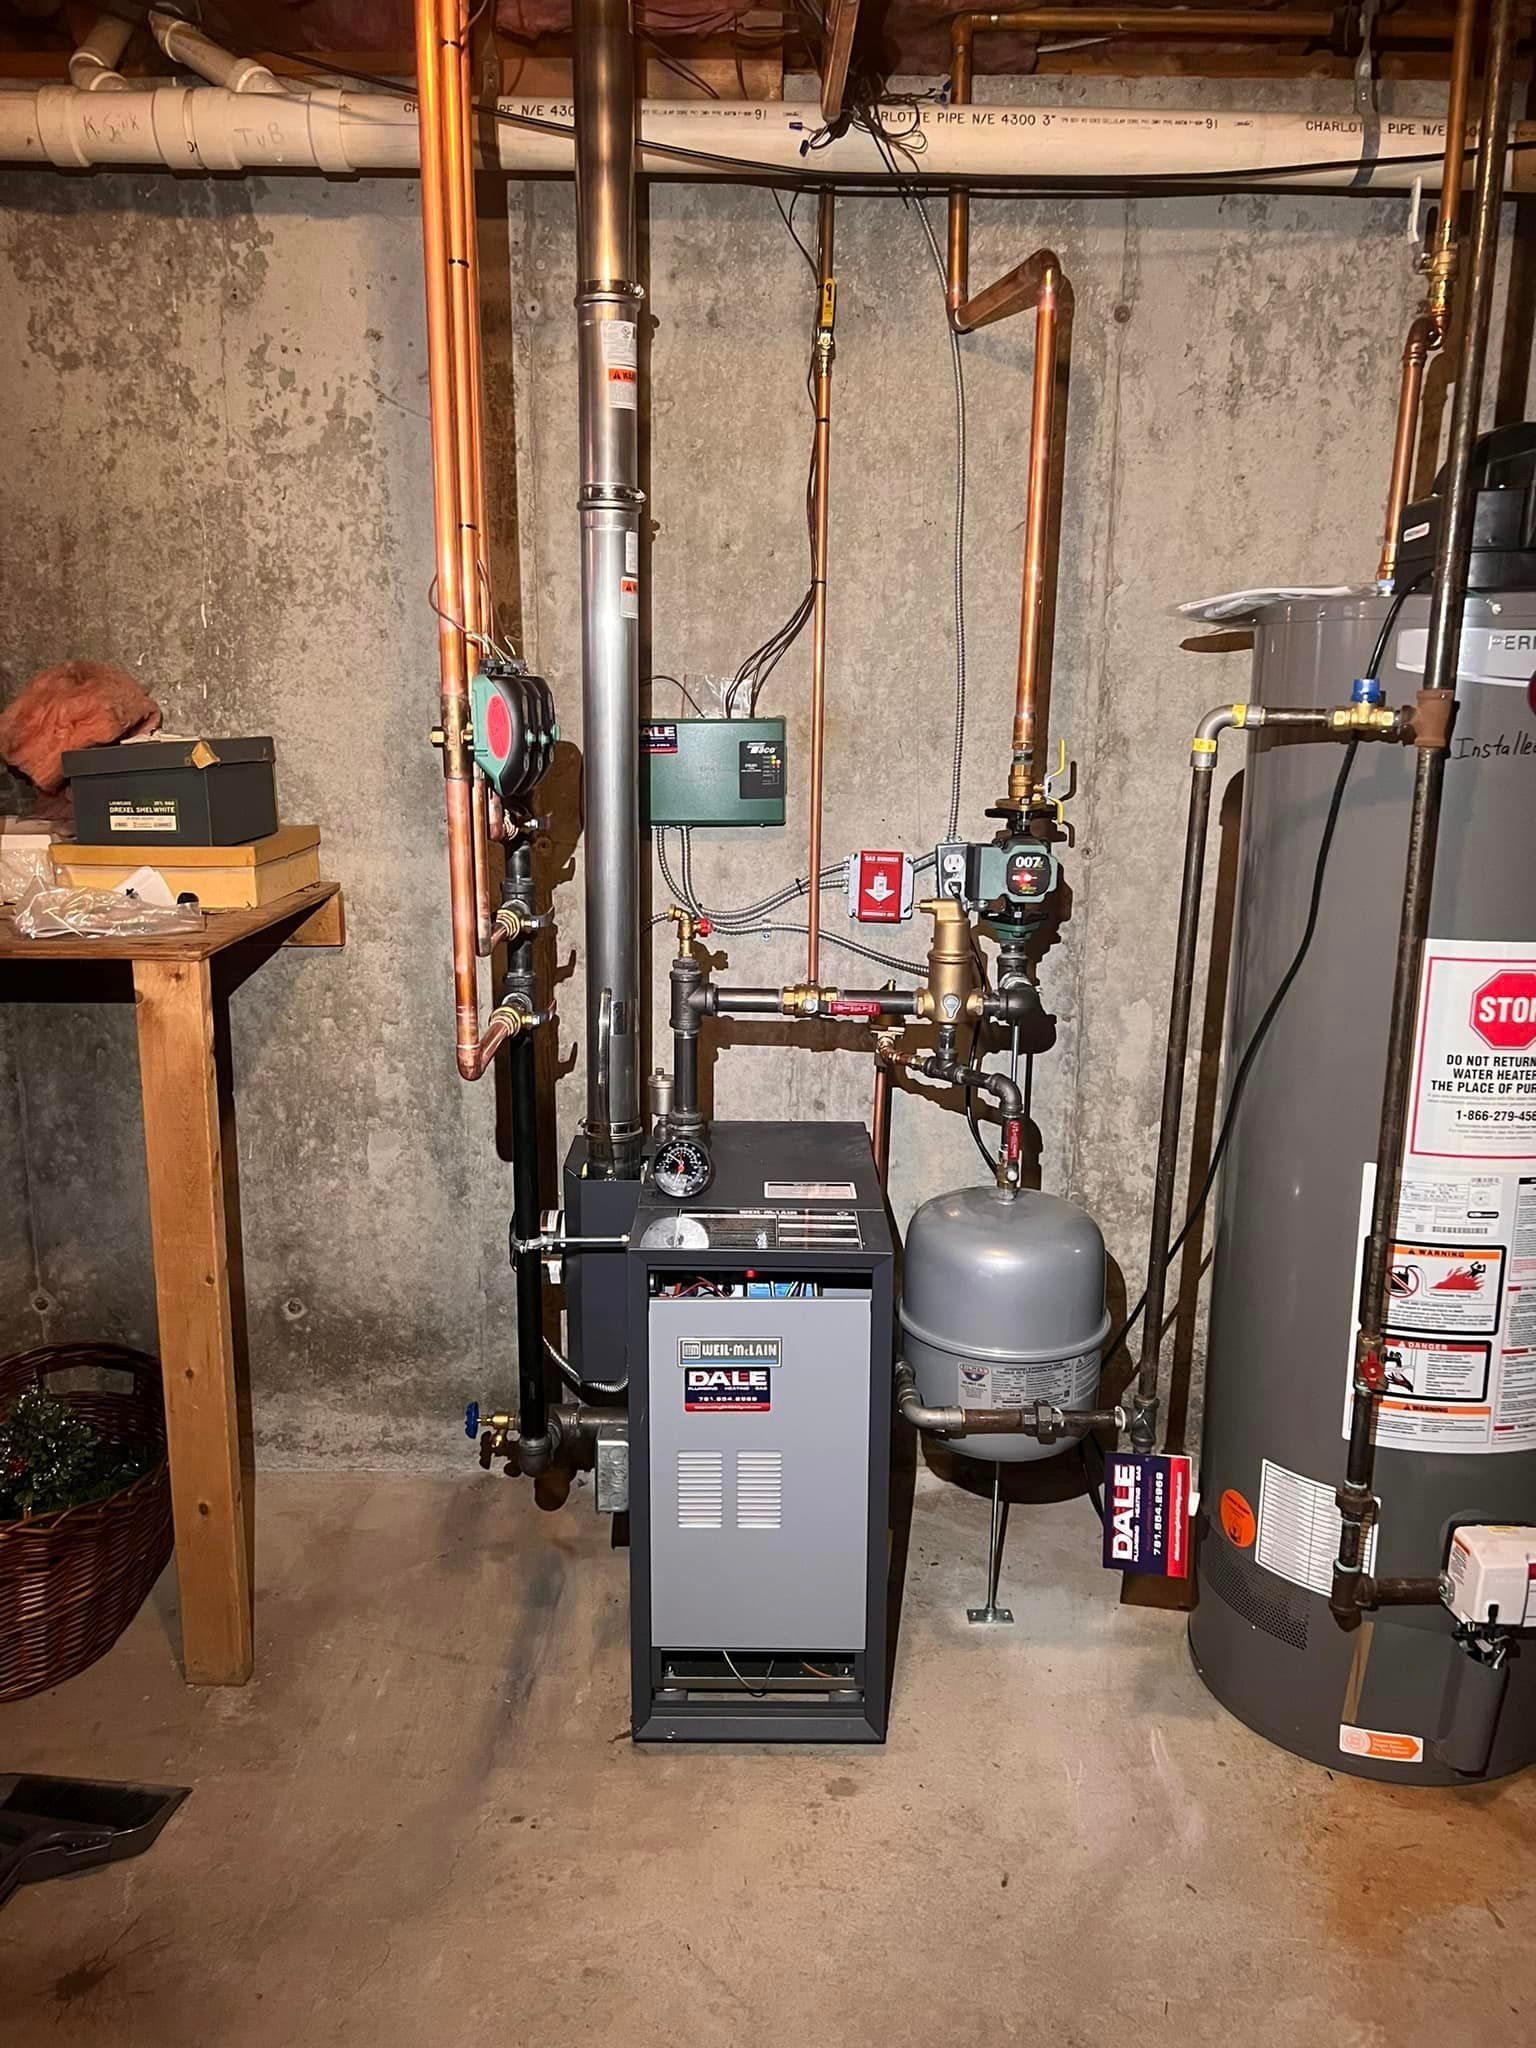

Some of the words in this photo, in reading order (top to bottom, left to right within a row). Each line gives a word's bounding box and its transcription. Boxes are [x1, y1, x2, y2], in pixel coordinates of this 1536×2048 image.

[937, 112, 965, 125] PIPE
[972, 113, 995, 125] N/E
[1001, 114, 1036, 127] 4300
[1388, 122, 1415, 136] PIPE
[1446, 1054, 1463, 1065] DO
[1466, 1055, 1490, 1067] NOT
[1453, 1067, 1493, 1080] WATER
[1431, 1079, 1453, 1092] THE
[1457, 1081, 1495, 1094] PLACE
[1498, 1082, 1513, 1094] OF
[1419, 1249, 1465, 1258] WARNING
[1408, 1341, 1448, 1351] DANGER
[688, 1371, 768, 1386] DALE
[1112, 1464, 1135, 1560] DALE
